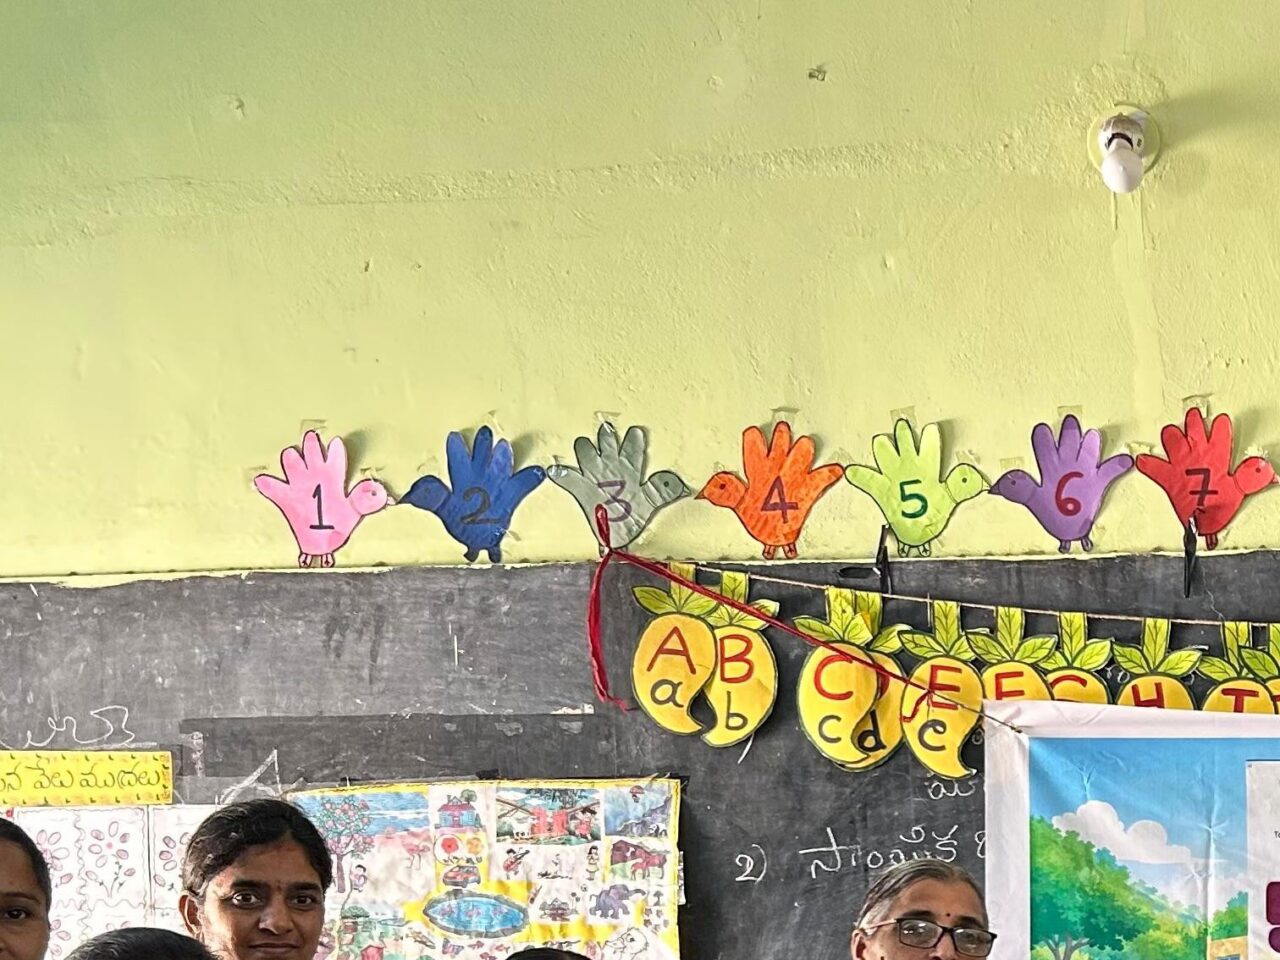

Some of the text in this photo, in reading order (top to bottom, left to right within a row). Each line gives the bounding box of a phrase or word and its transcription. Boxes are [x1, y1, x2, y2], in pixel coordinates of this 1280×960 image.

[461, 488, 500, 525] 2
[597, 480, 632, 522] 3
[761, 475, 798, 524] 4
[899, 479, 929, 518] 5
[1054, 472, 1084, 516] 6
[1185, 467, 1219, 507] 7
[310, 488, 334, 530] 1
[647, 626, 696, 675] A
[719, 634, 755, 684] B
[651, 679, 684, 708] a
[814, 654, 854, 700] C
[930, 664, 960, 710] E
[727, 691, 748, 731] b
[818, 715, 842, 743] c
[918, 719, 947, 751] e
